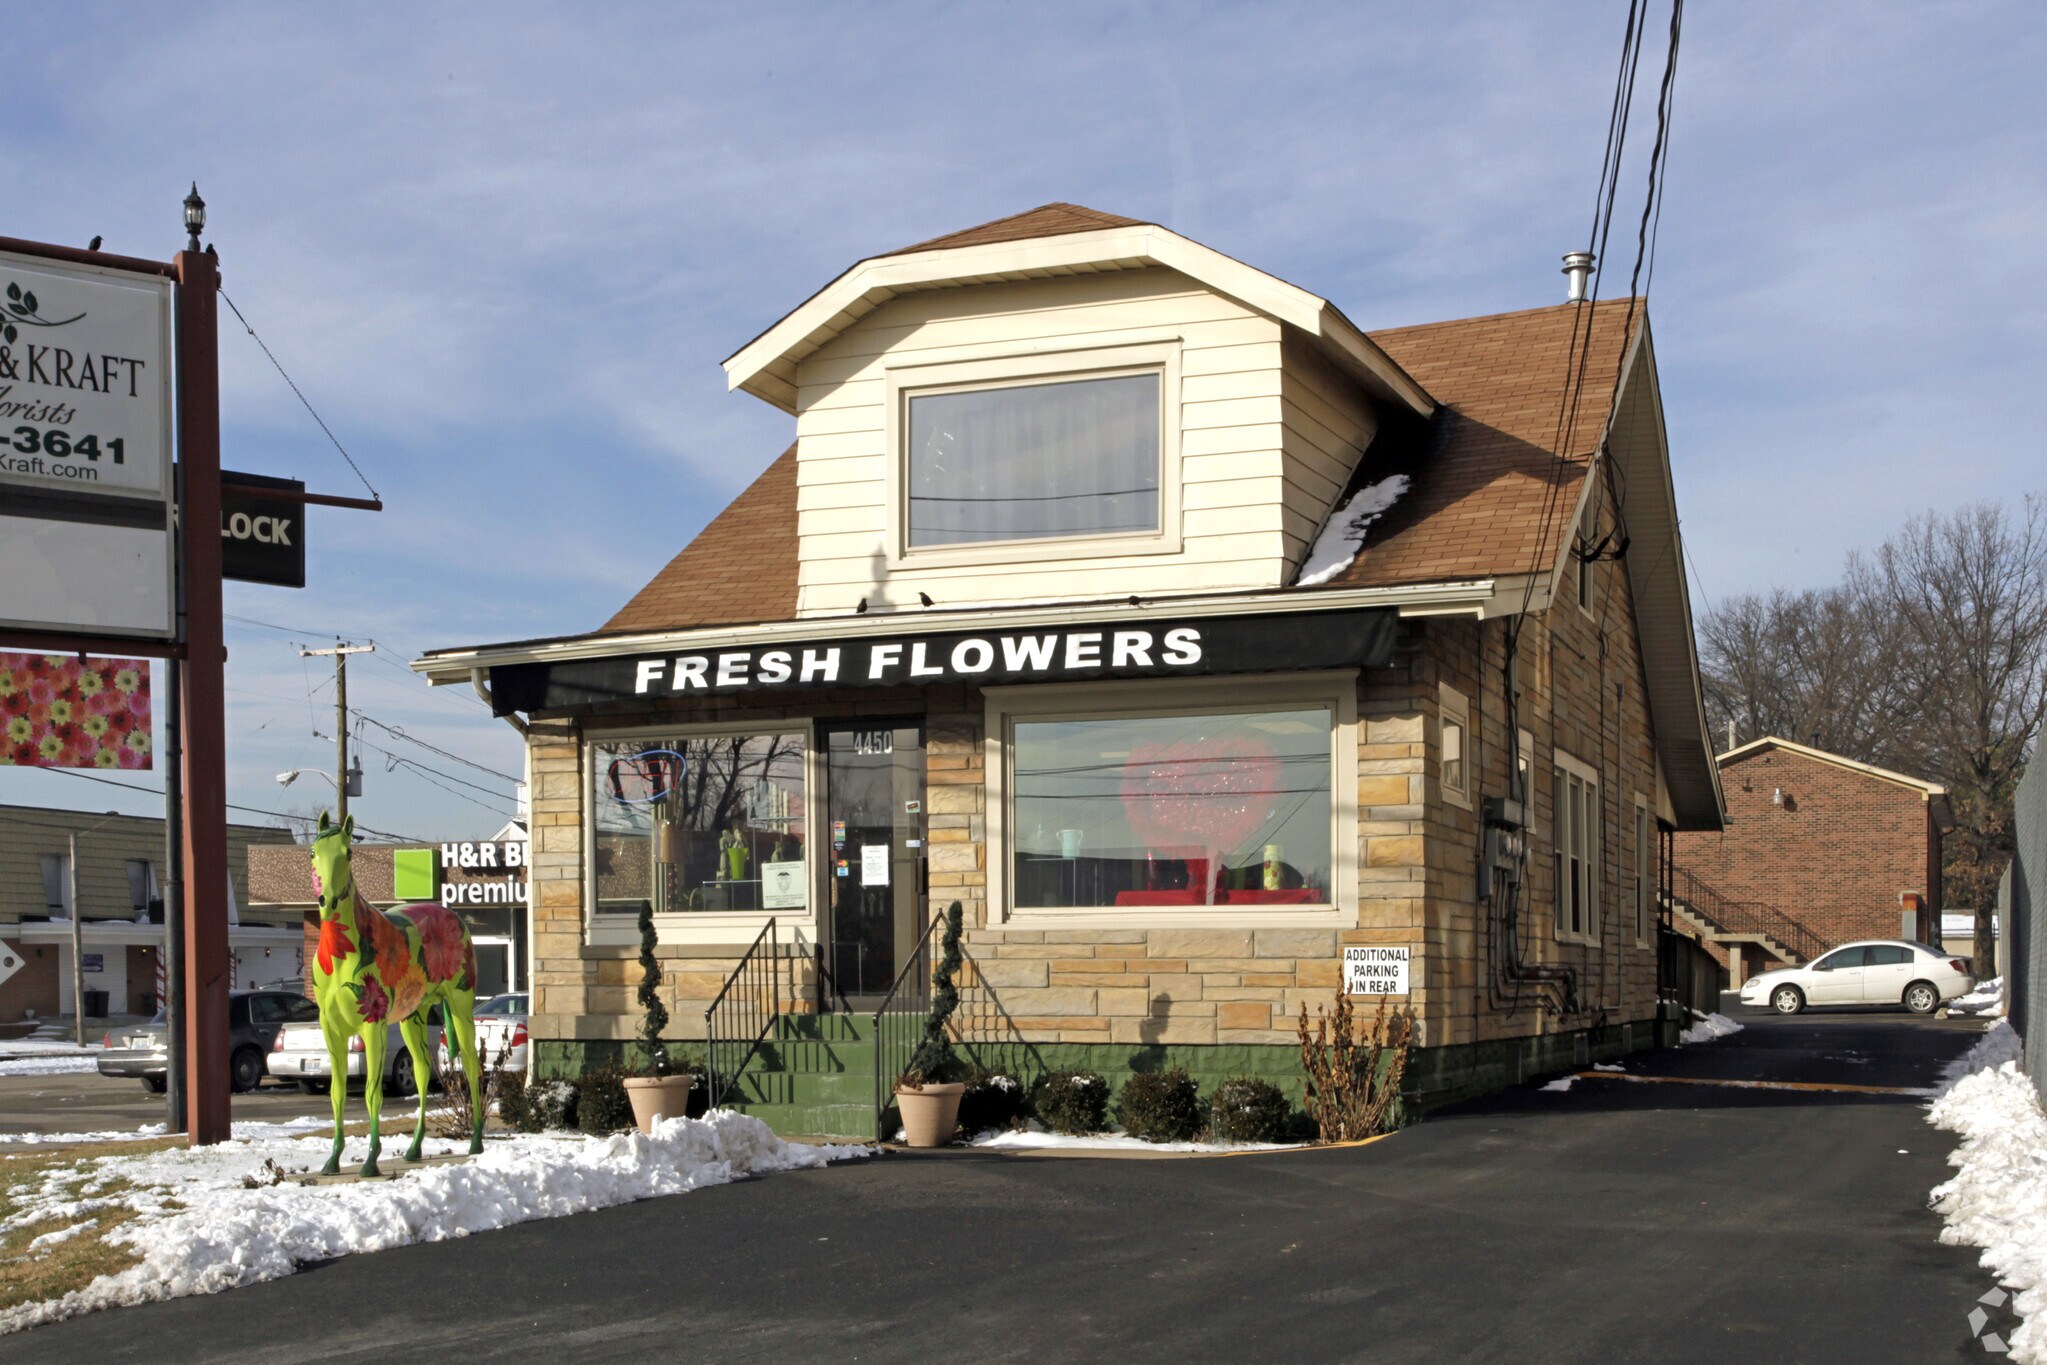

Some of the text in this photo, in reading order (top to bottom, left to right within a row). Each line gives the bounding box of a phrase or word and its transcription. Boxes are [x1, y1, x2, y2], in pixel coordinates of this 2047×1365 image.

[0, 426, 124, 465] -3641
[635, 628, 1203, 694] FRESH FLOWERS
[854, 731, 893, 756] 4450
[606, 759, 681, 793] OPEN
[441, 842, 499, 868] H&R
[1346, 949, 1408, 961] ADDITIONAL
[1354, 964, 1399, 977] PARKING
[1355, 980, 1397, 993] IN REAR
